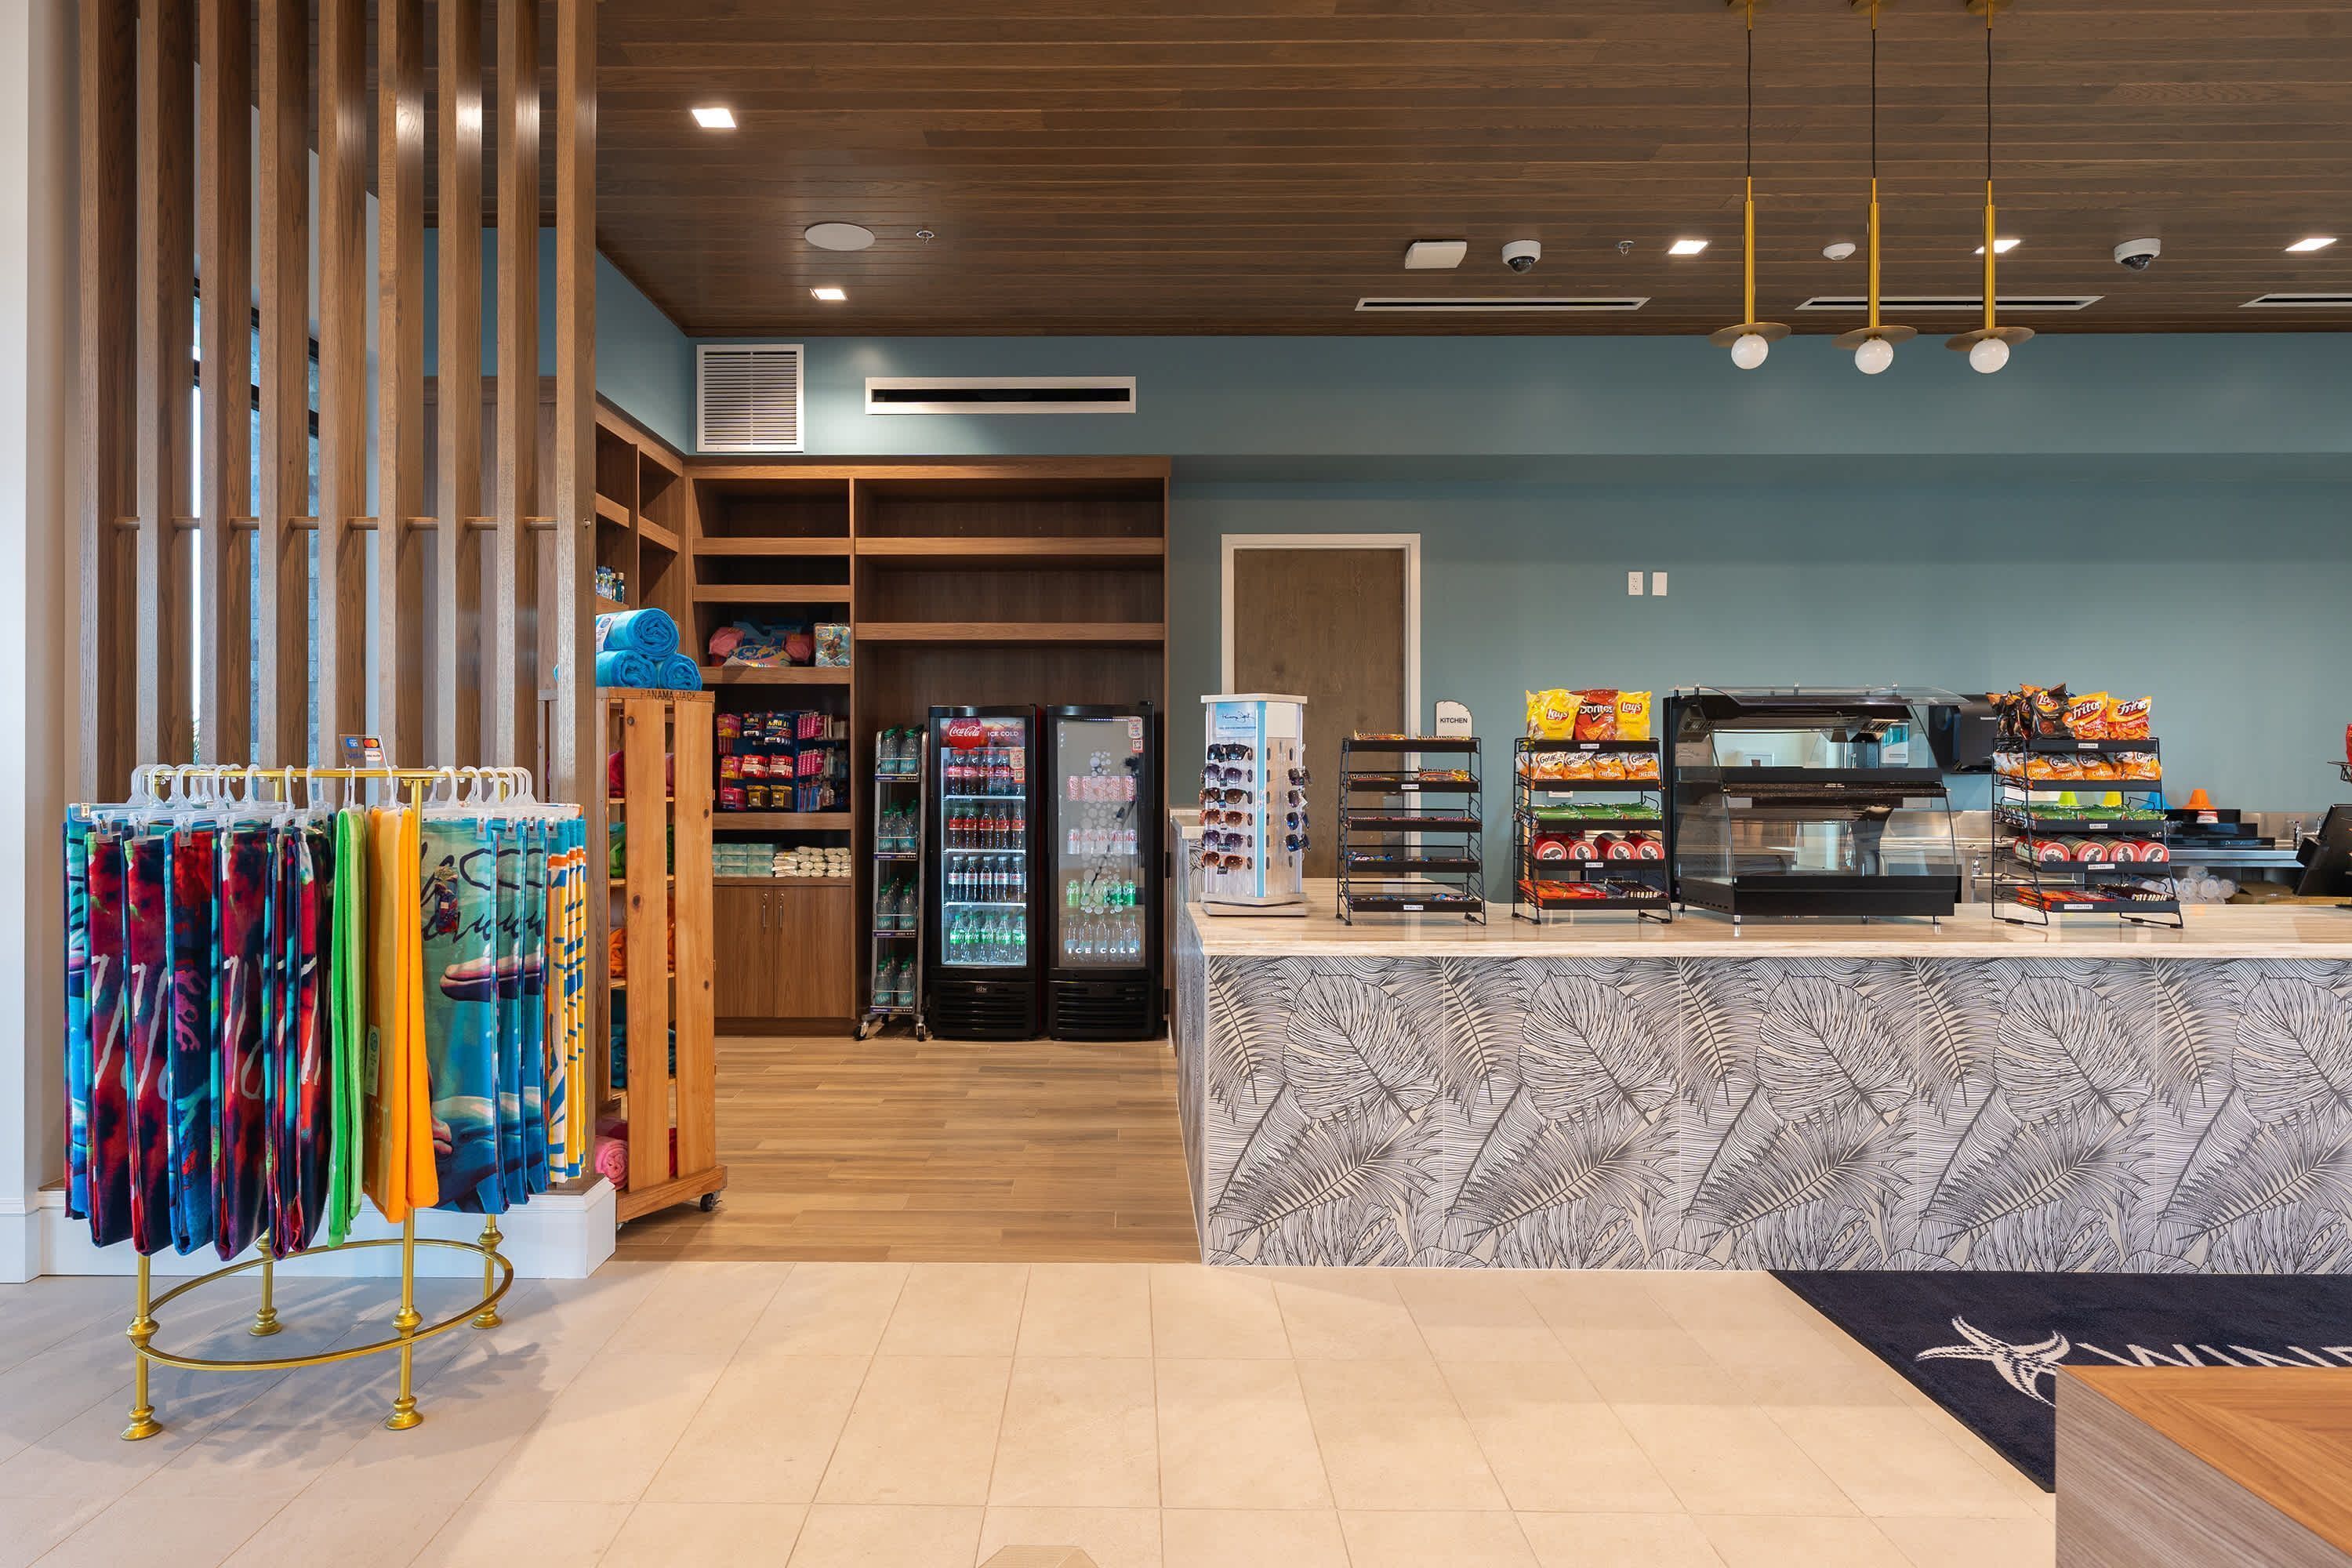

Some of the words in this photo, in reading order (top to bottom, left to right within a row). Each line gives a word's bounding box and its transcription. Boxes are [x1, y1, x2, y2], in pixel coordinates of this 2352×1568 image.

[641, 690, 673, 700] PANAMA
[677, 691, 696, 701] JACK
[1580, 705, 1613, 714] Doritos
[2071, 701, 2100, 720] Fritos
[2118, 700, 2147, 715] Fritos
